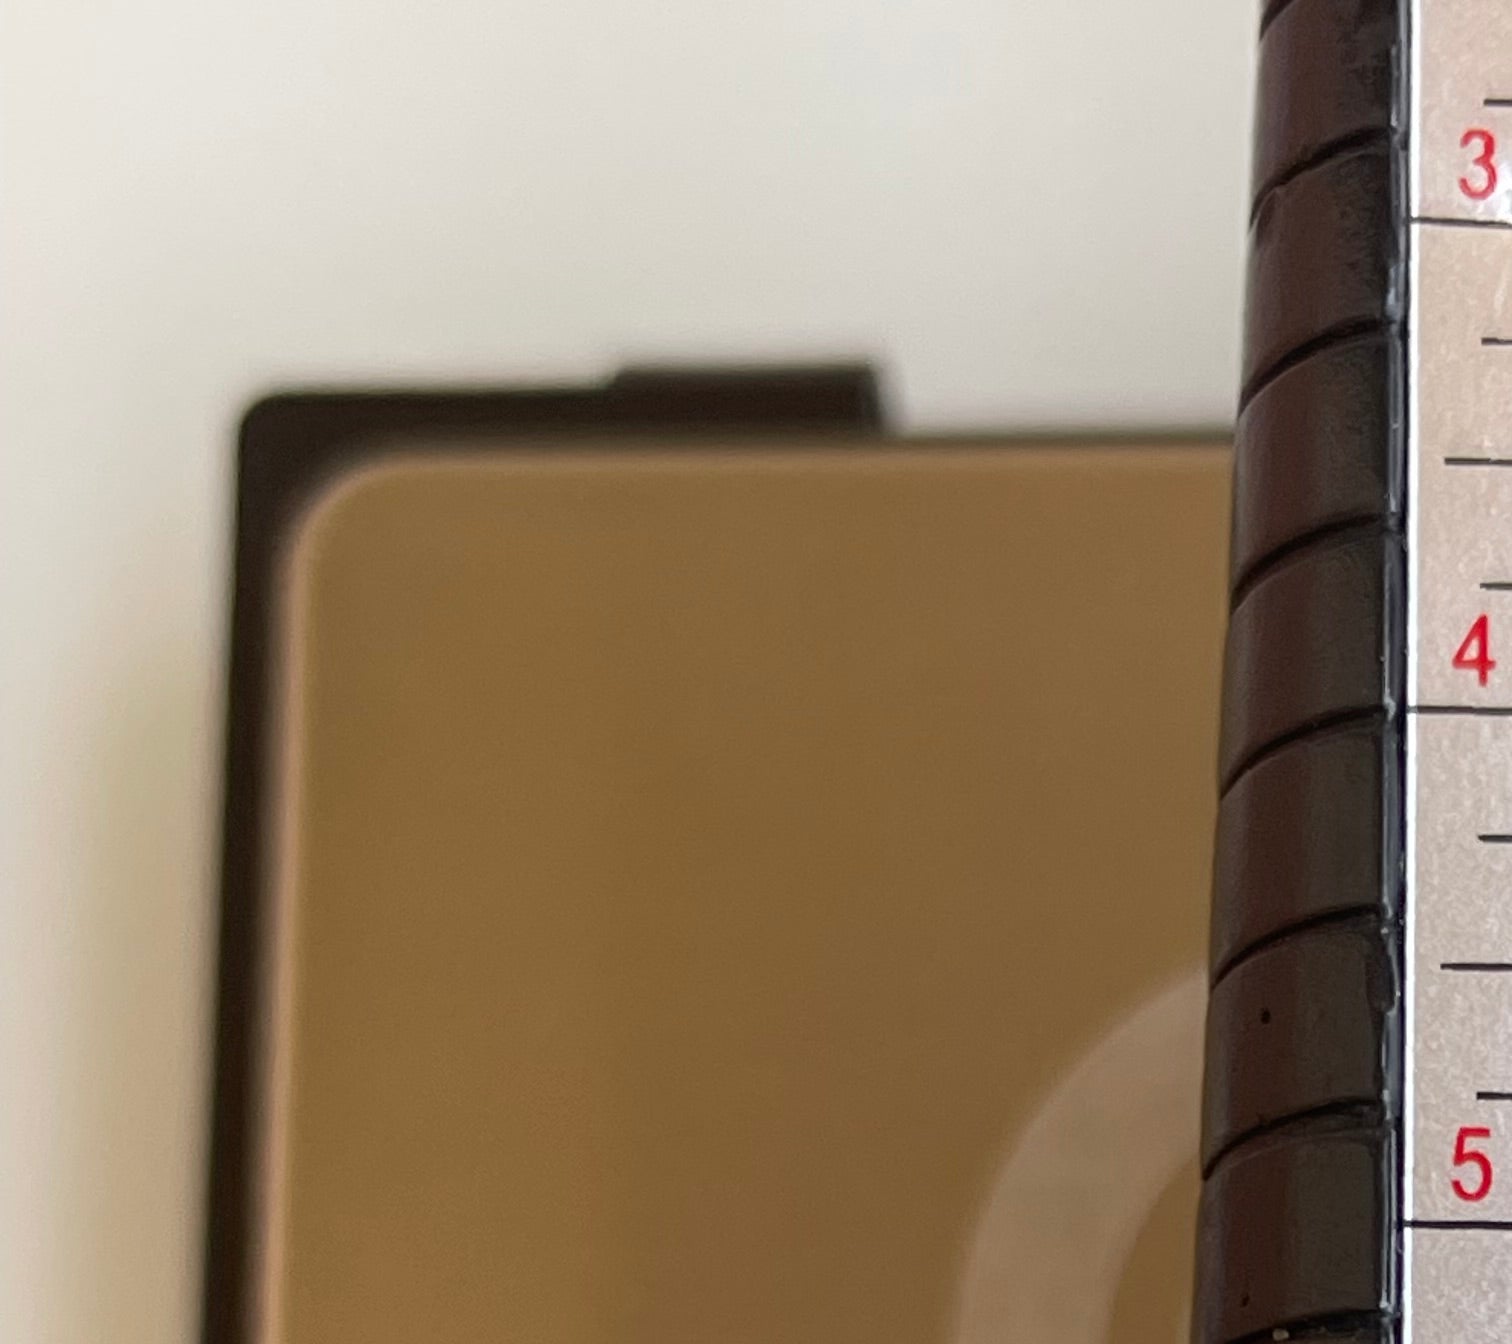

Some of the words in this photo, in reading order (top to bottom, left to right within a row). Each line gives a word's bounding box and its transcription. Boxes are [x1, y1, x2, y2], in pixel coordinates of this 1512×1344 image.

[1460, 128, 1498, 199] 3
[1452, 613, 1496, 686] 4
[1451, 1125, 1493, 1202] 5
